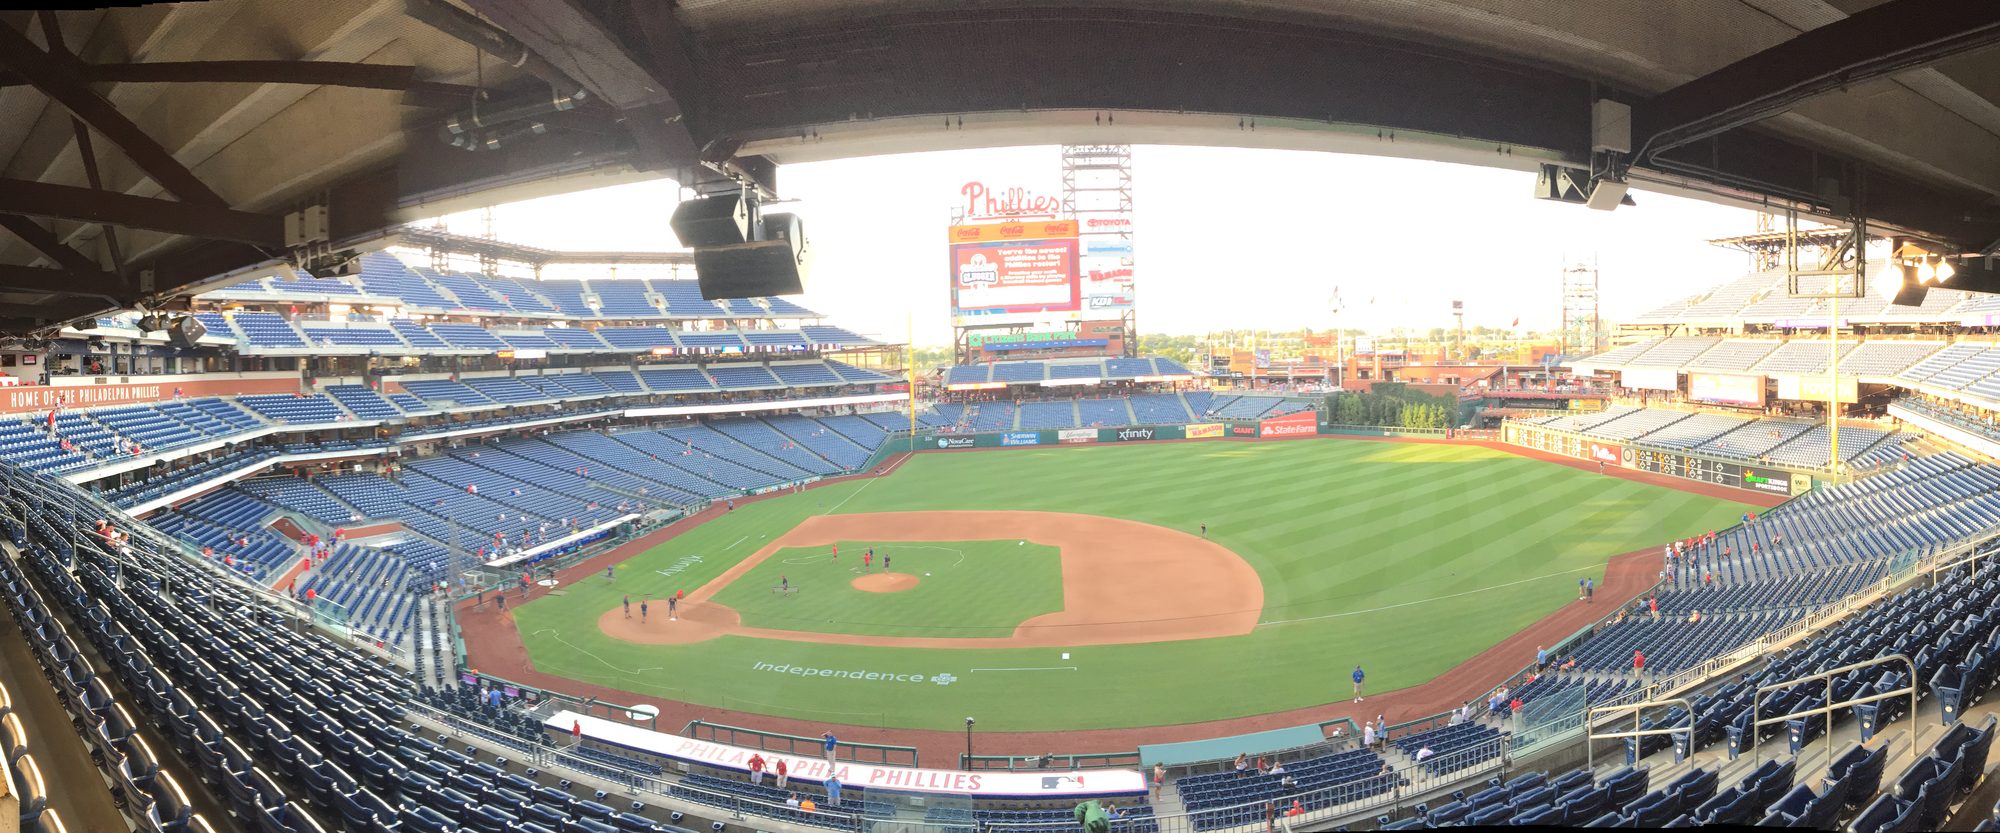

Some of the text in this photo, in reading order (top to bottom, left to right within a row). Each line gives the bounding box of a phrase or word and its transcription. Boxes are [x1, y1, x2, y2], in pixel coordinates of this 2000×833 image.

[961, 181, 1059, 215] Phillies
[984, 331, 1077, 344] Citizens Bank Park
[11, 391, 39, 408] HOME
[43, 390, 54, 405] OF
[131, 385, 160, 399] PHILLIES
[1803, 383, 1852, 396] TOYOA
[1119, 428, 1153, 440] xfinity
[752, 661, 924, 682] Independence
[676, 741, 982, 790] PHILAEPHIA PHILLIES
